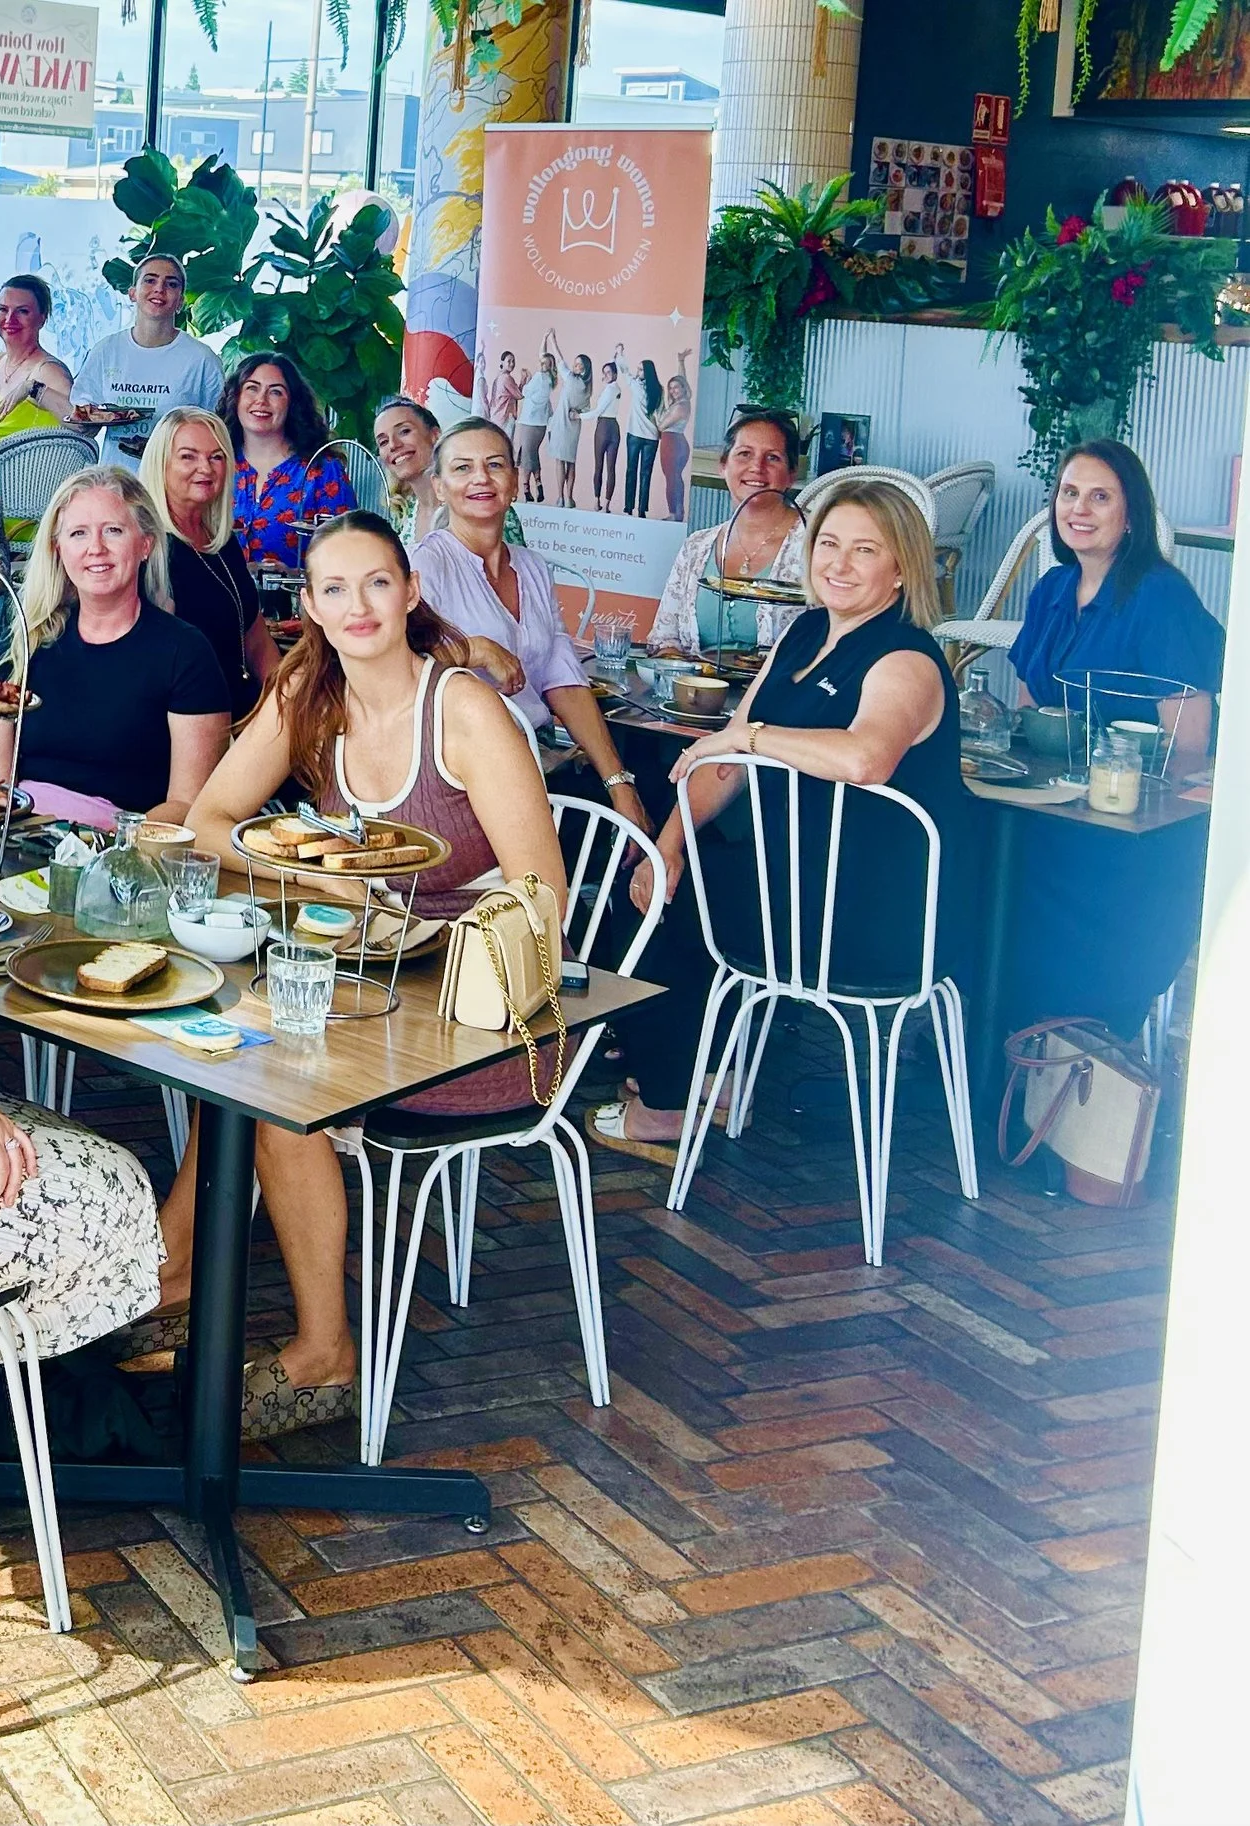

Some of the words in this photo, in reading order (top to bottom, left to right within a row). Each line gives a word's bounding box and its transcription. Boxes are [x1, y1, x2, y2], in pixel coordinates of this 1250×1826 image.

[523, 144, 614, 224] wollongong
[616, 154, 655, 228] women
[523, 233, 606, 295] WOLLONGONG
[608, 238, 652, 289] WOMEN
[110, 383, 171, 394] MARGARITA
[520, 515, 560, 530] latform
[563, 520, 579, 533] for
[582, 526, 622, 538] women
[625, 531, 636, 541] in
[538, 540, 550, 550] to
[552, 540, 567, 552] be
[570, 545, 598, 558] seen,
[600, 549, 646, 565] connect,
